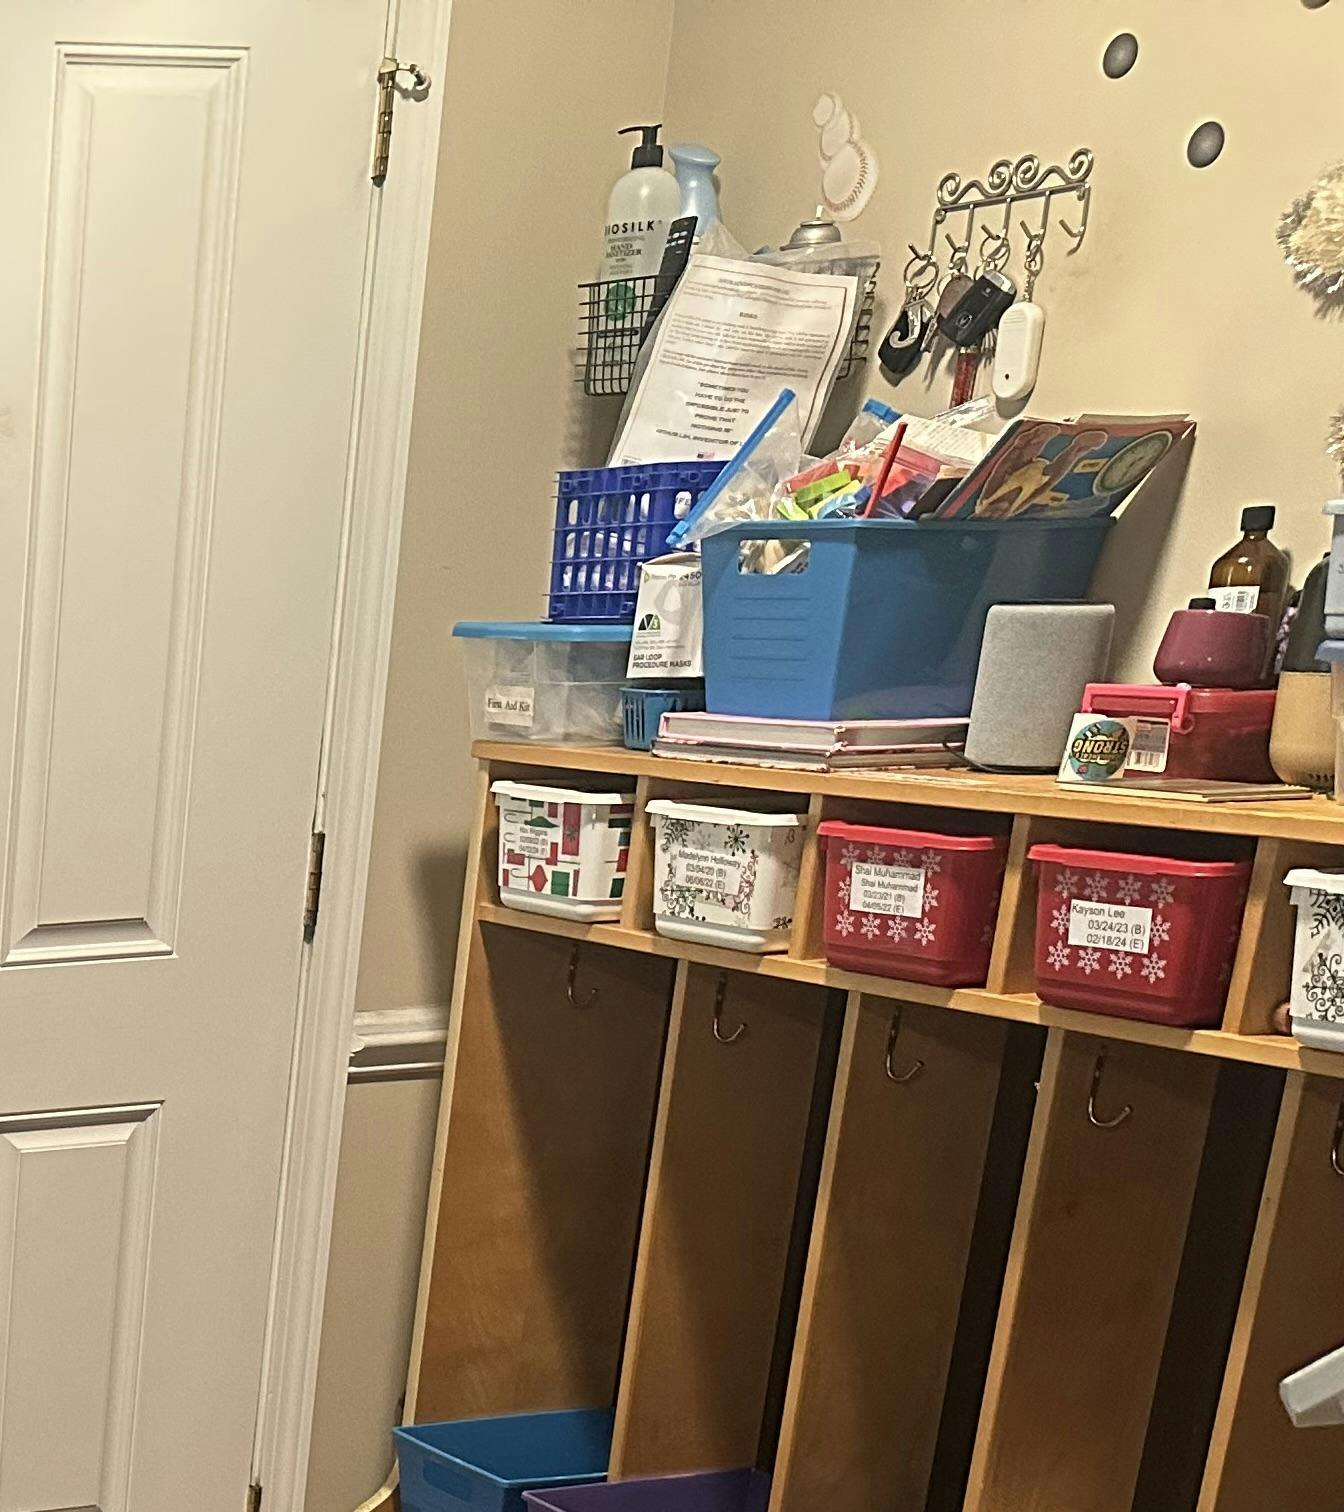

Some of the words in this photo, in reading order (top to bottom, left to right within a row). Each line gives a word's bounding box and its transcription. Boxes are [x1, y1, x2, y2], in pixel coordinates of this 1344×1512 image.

[519, 701, 530, 712] Kit
[1072, 904, 1105, 917] Kayson
[1108, 907, 1125, 918] Lee
[1088, 920, 1128, 933] 03/24/23
[1131, 924, 1145, 936] (B)
[1130, 939, 1144, 951] (E)
